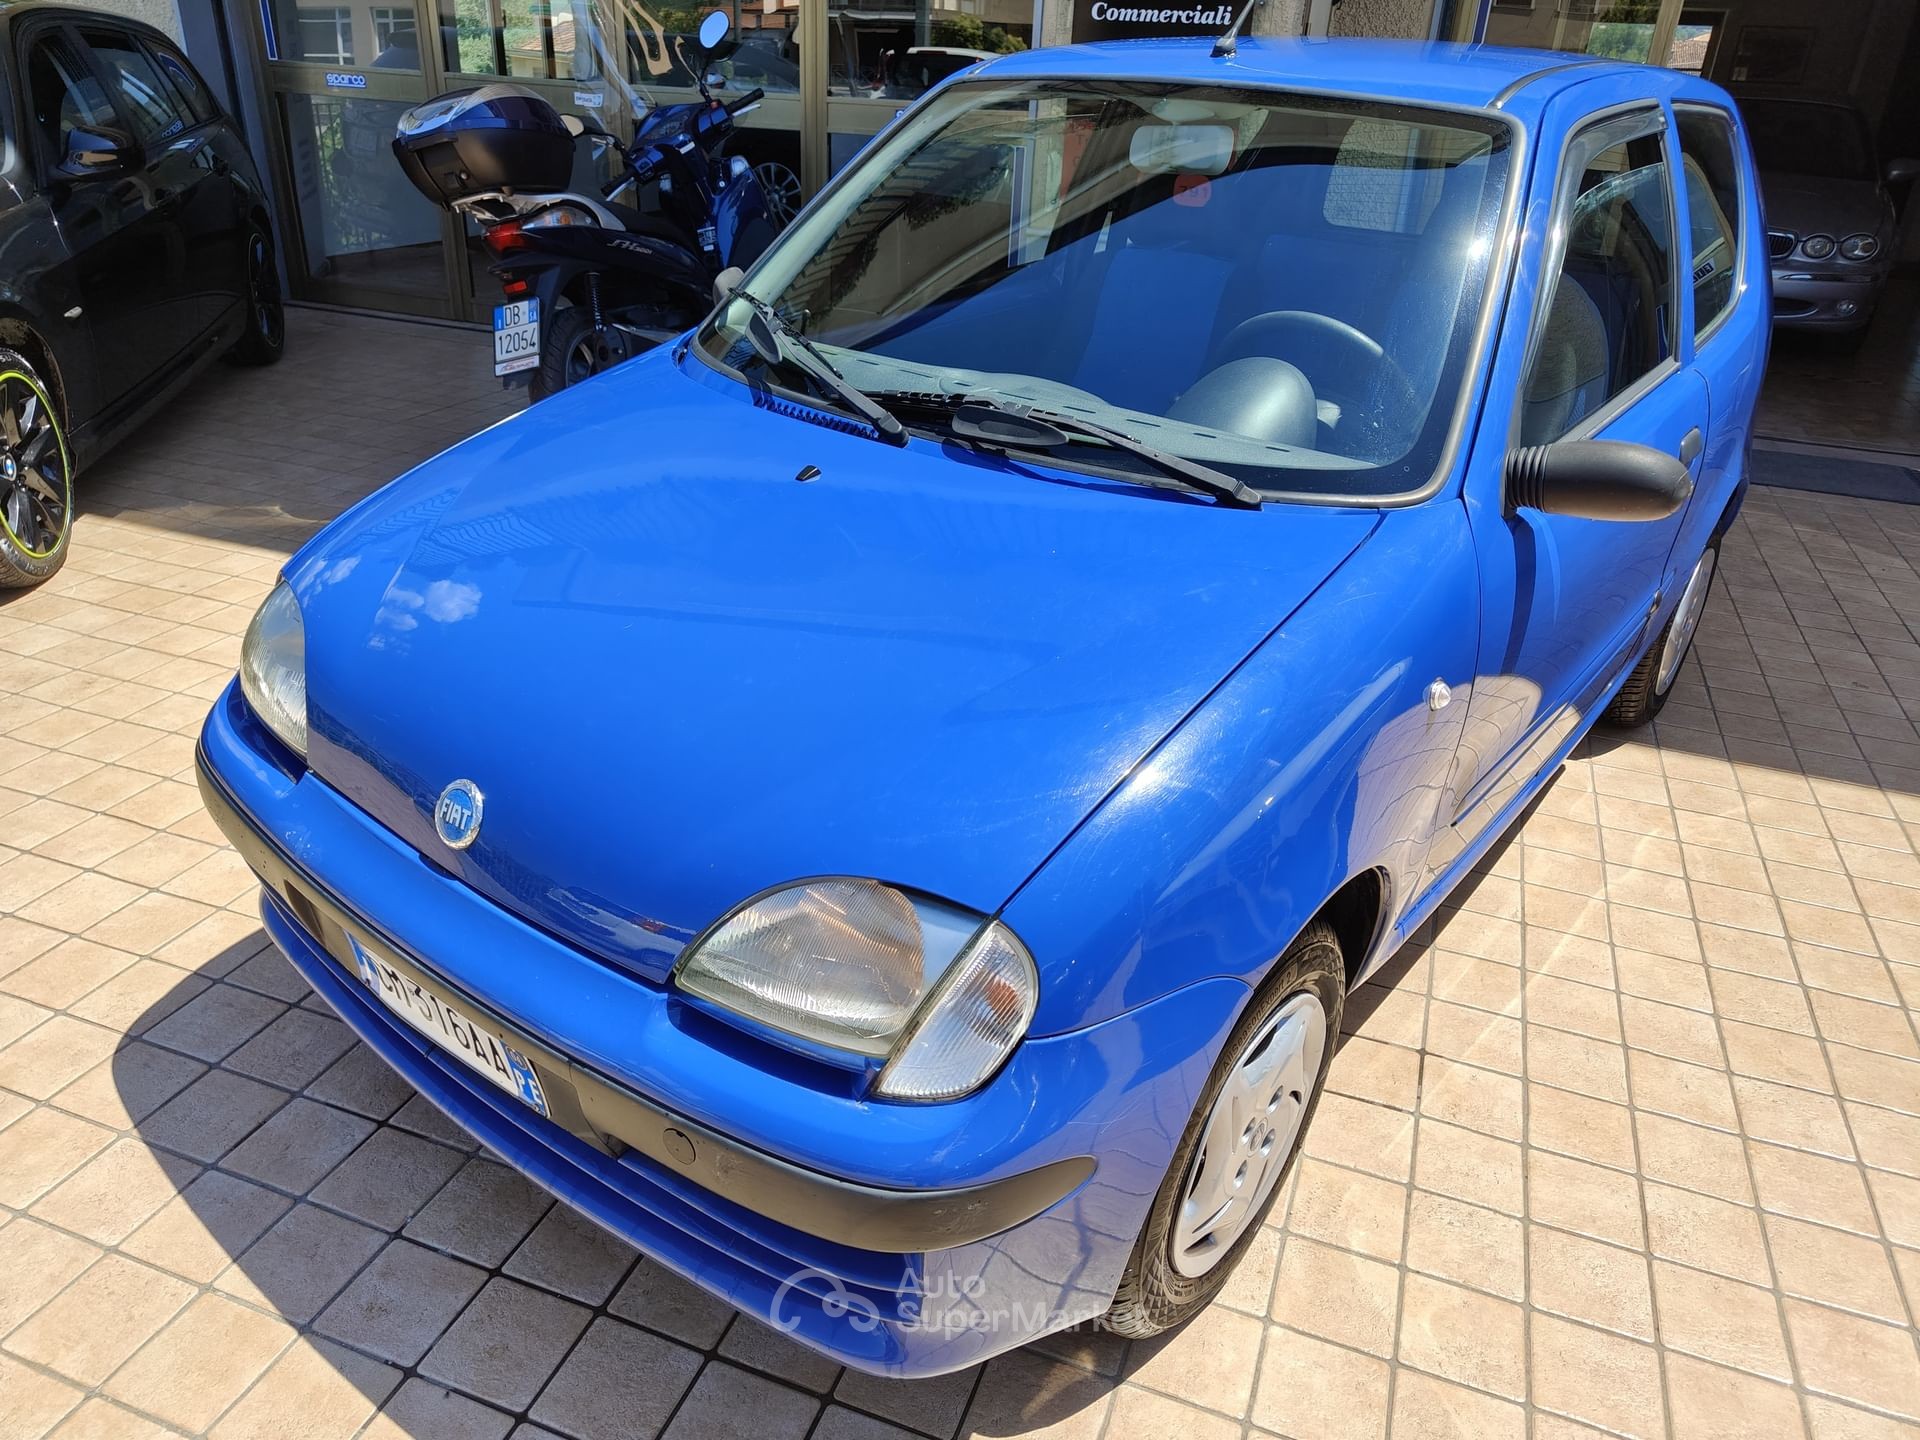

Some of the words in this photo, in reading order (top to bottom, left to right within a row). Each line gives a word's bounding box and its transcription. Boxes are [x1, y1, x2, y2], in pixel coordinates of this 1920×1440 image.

[1091, 1, 1232, 26] Commerciali
[326, 73, 367, 86] sparco
[504, 305, 520, 326] DB
[499, 327, 536, 355] 12054
[440, 798, 472, 830] FIAT
[513, 1068, 543, 1105] PE
